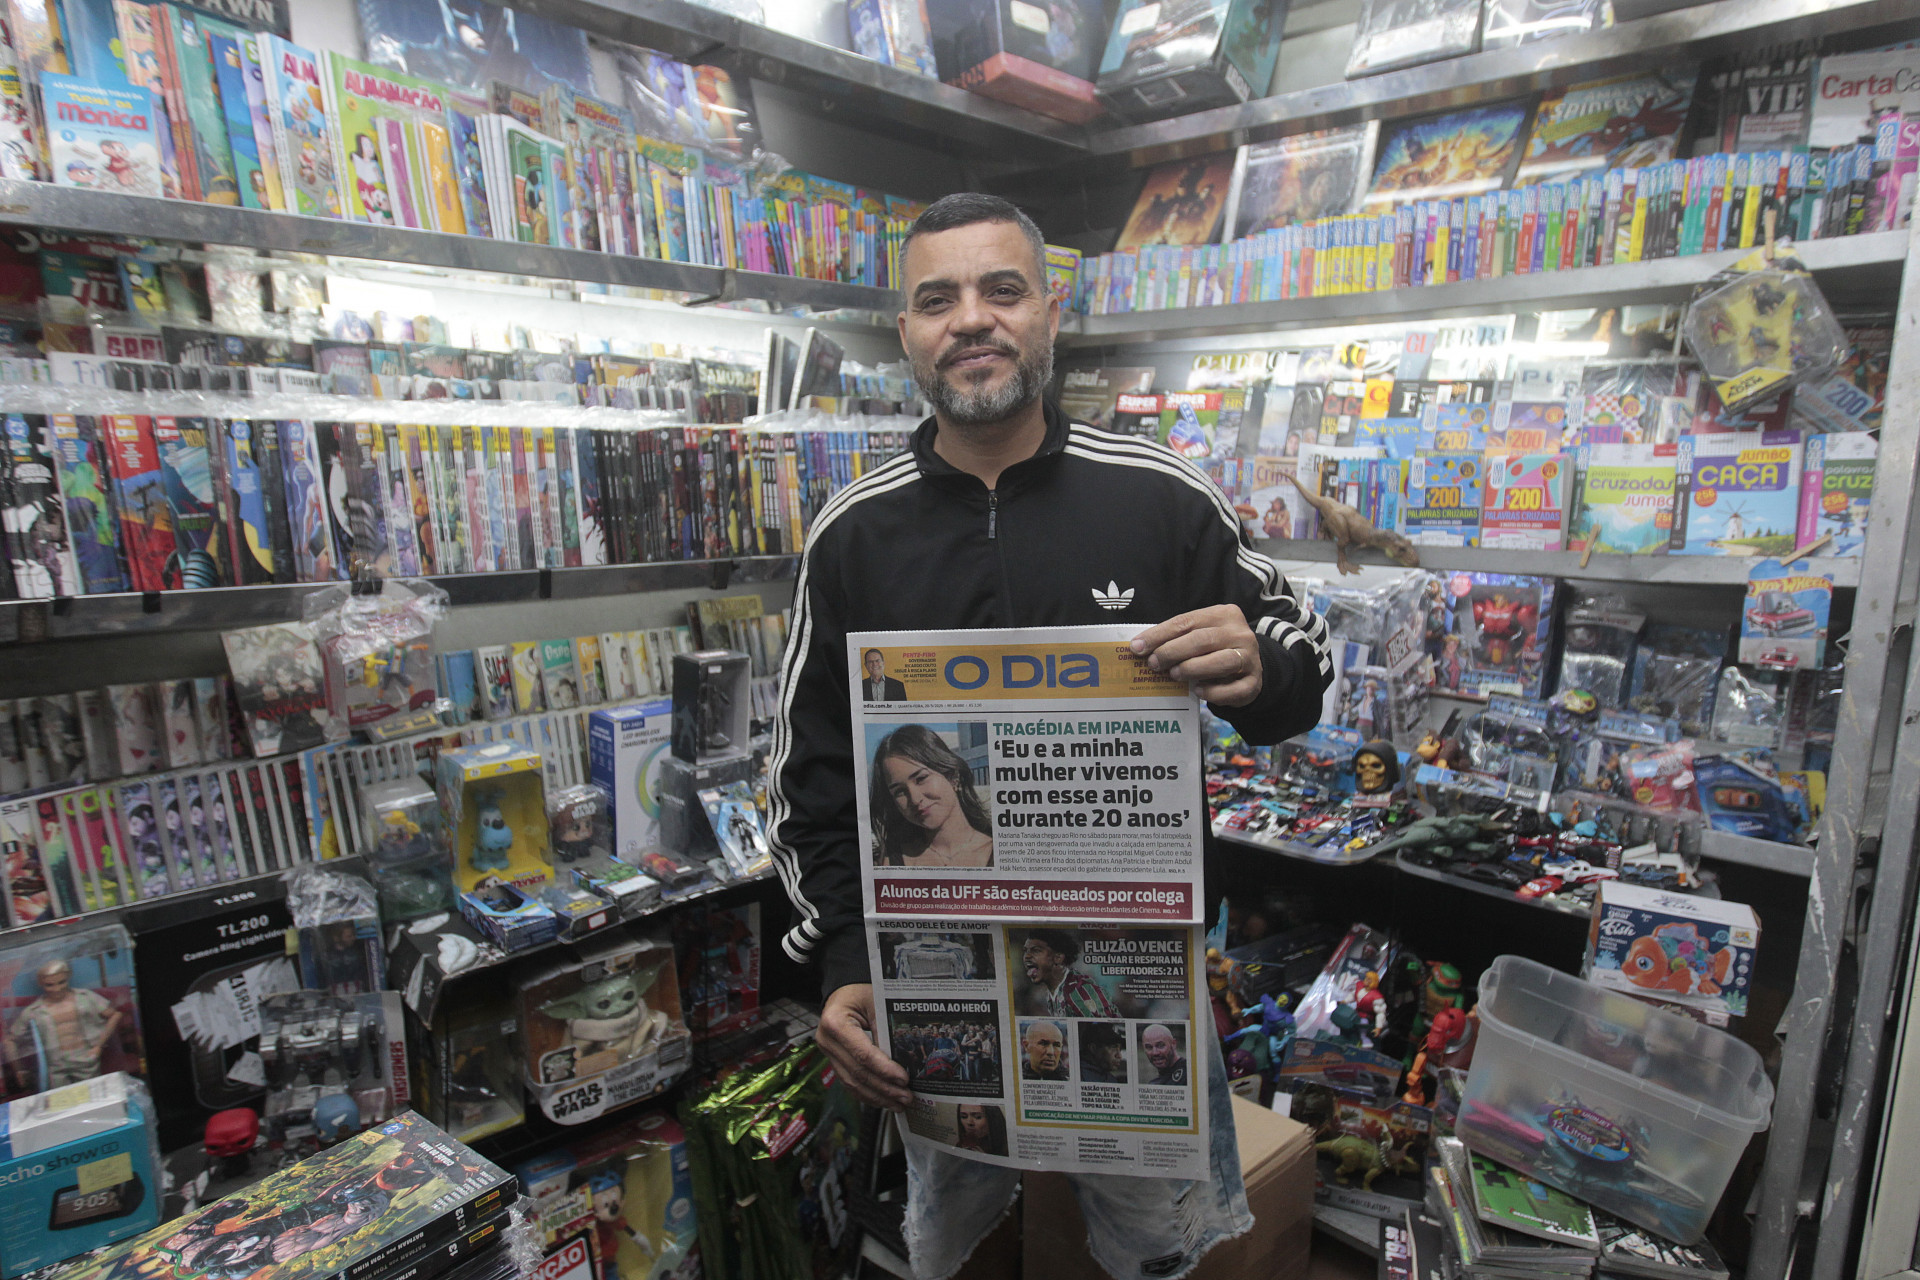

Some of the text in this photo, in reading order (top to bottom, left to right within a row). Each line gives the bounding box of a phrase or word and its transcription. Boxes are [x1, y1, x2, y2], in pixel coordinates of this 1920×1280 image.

[1740, 448, 1790, 462] JUMBO
[1697, 464, 1779, 490] CAÇA
[1407, 509, 1478, 519] PALAVRAS CRUZADAS
[944, 655, 989, 690] O
[993, 719, 1182, 736] TRAGÉDIA EM IPANEMA
[1034, 743, 1047, 757] e
[1052, 743, 1066, 758] a
[1070, 738, 1144, 758] minha
[995, 762, 1179, 782] mulher vivemos
[996, 785, 1153, 807] com esse anjo
[997, 809, 1088, 828] durante
[1092, 808, 1122, 828] 20
[1036, 840, 1078, 848] desgovernada
[1042, 832, 1062, 840] chegou
[880, 884, 1185, 906] Alunos da UFF são esfaqueados por colega
[217, 914, 270, 937] TL200
[940, 920, 946, 929] É
[183, 947, 219, 961] Camera
[220, 942, 241, 952] Ring
[241, 934, 264, 946] Light
[1084, 938, 1183, 953] FLUZÃO VENCE
[1084, 954, 1184, 964] O BOLÍVAR E RESPIRA NA
[1102, 966, 1166, 975] LIBERTADORES:
[1166, 967, 1173, 975] 2
[1173, 967, 1180, 975] A
[893, 1002, 991, 1013] DESPEDIDA AO HERÓI
[558, 1083, 602, 1104] STAR
[552, 1092, 602, 1119] WARS
[1552, 1120, 1564, 1128] 12
[47, 1147, 99, 1172] show
[398, 1231, 424, 1250] BATMAN
